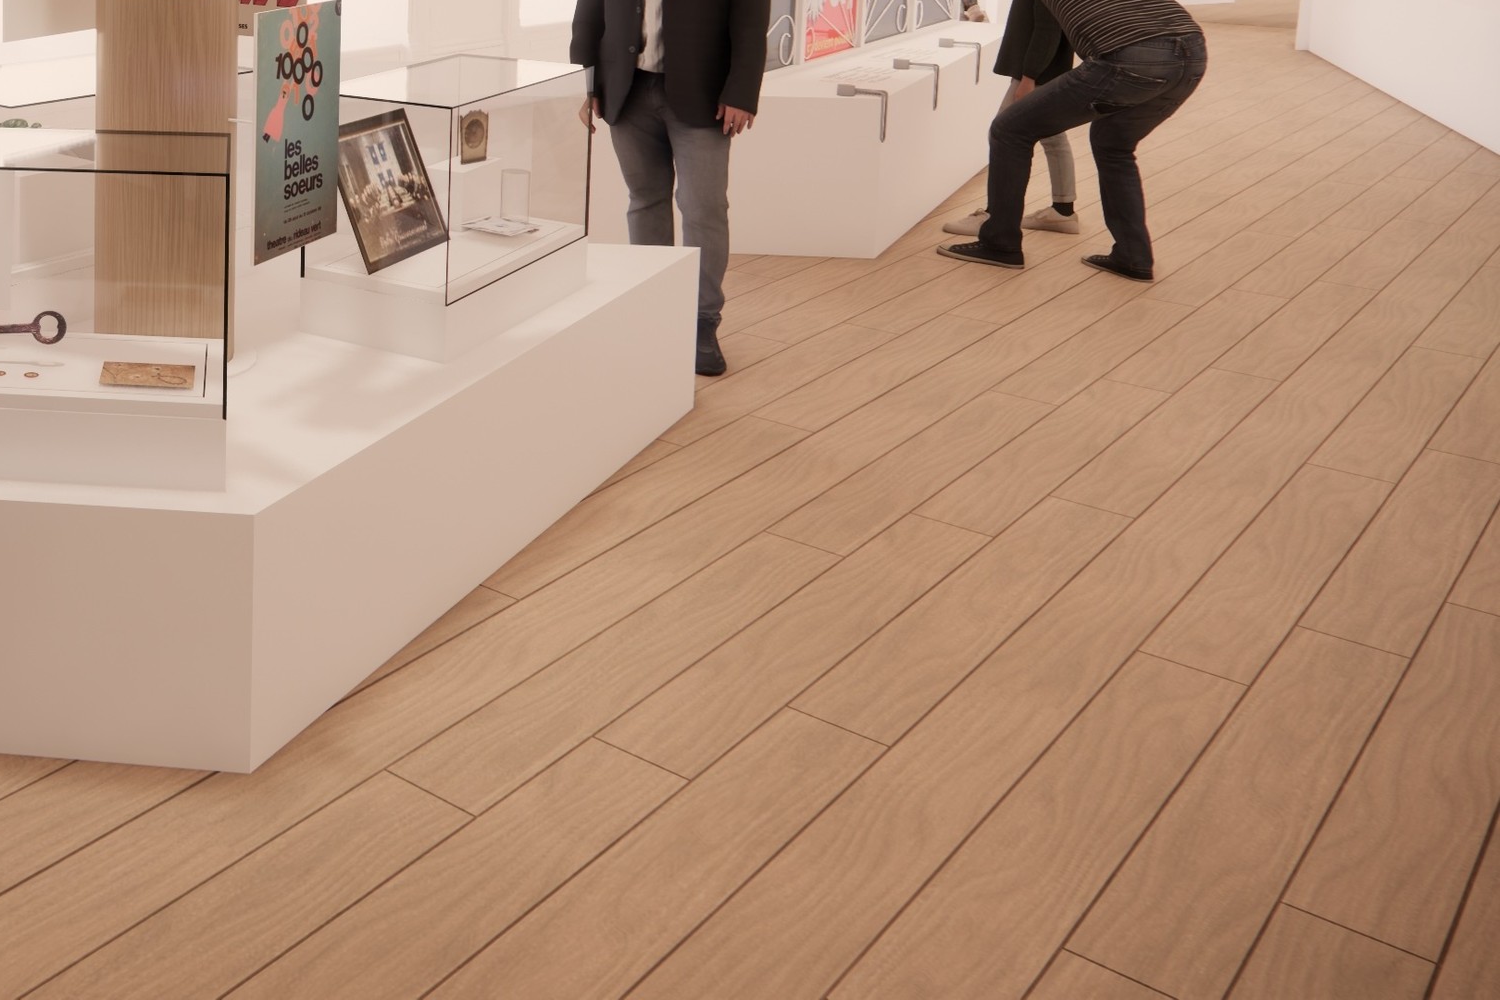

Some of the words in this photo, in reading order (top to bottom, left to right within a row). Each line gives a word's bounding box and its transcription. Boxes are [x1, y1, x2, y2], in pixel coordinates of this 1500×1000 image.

[284, 138, 302, 159] les
[284, 154, 318, 180] belles
[284, 173, 323, 200] soeurs
